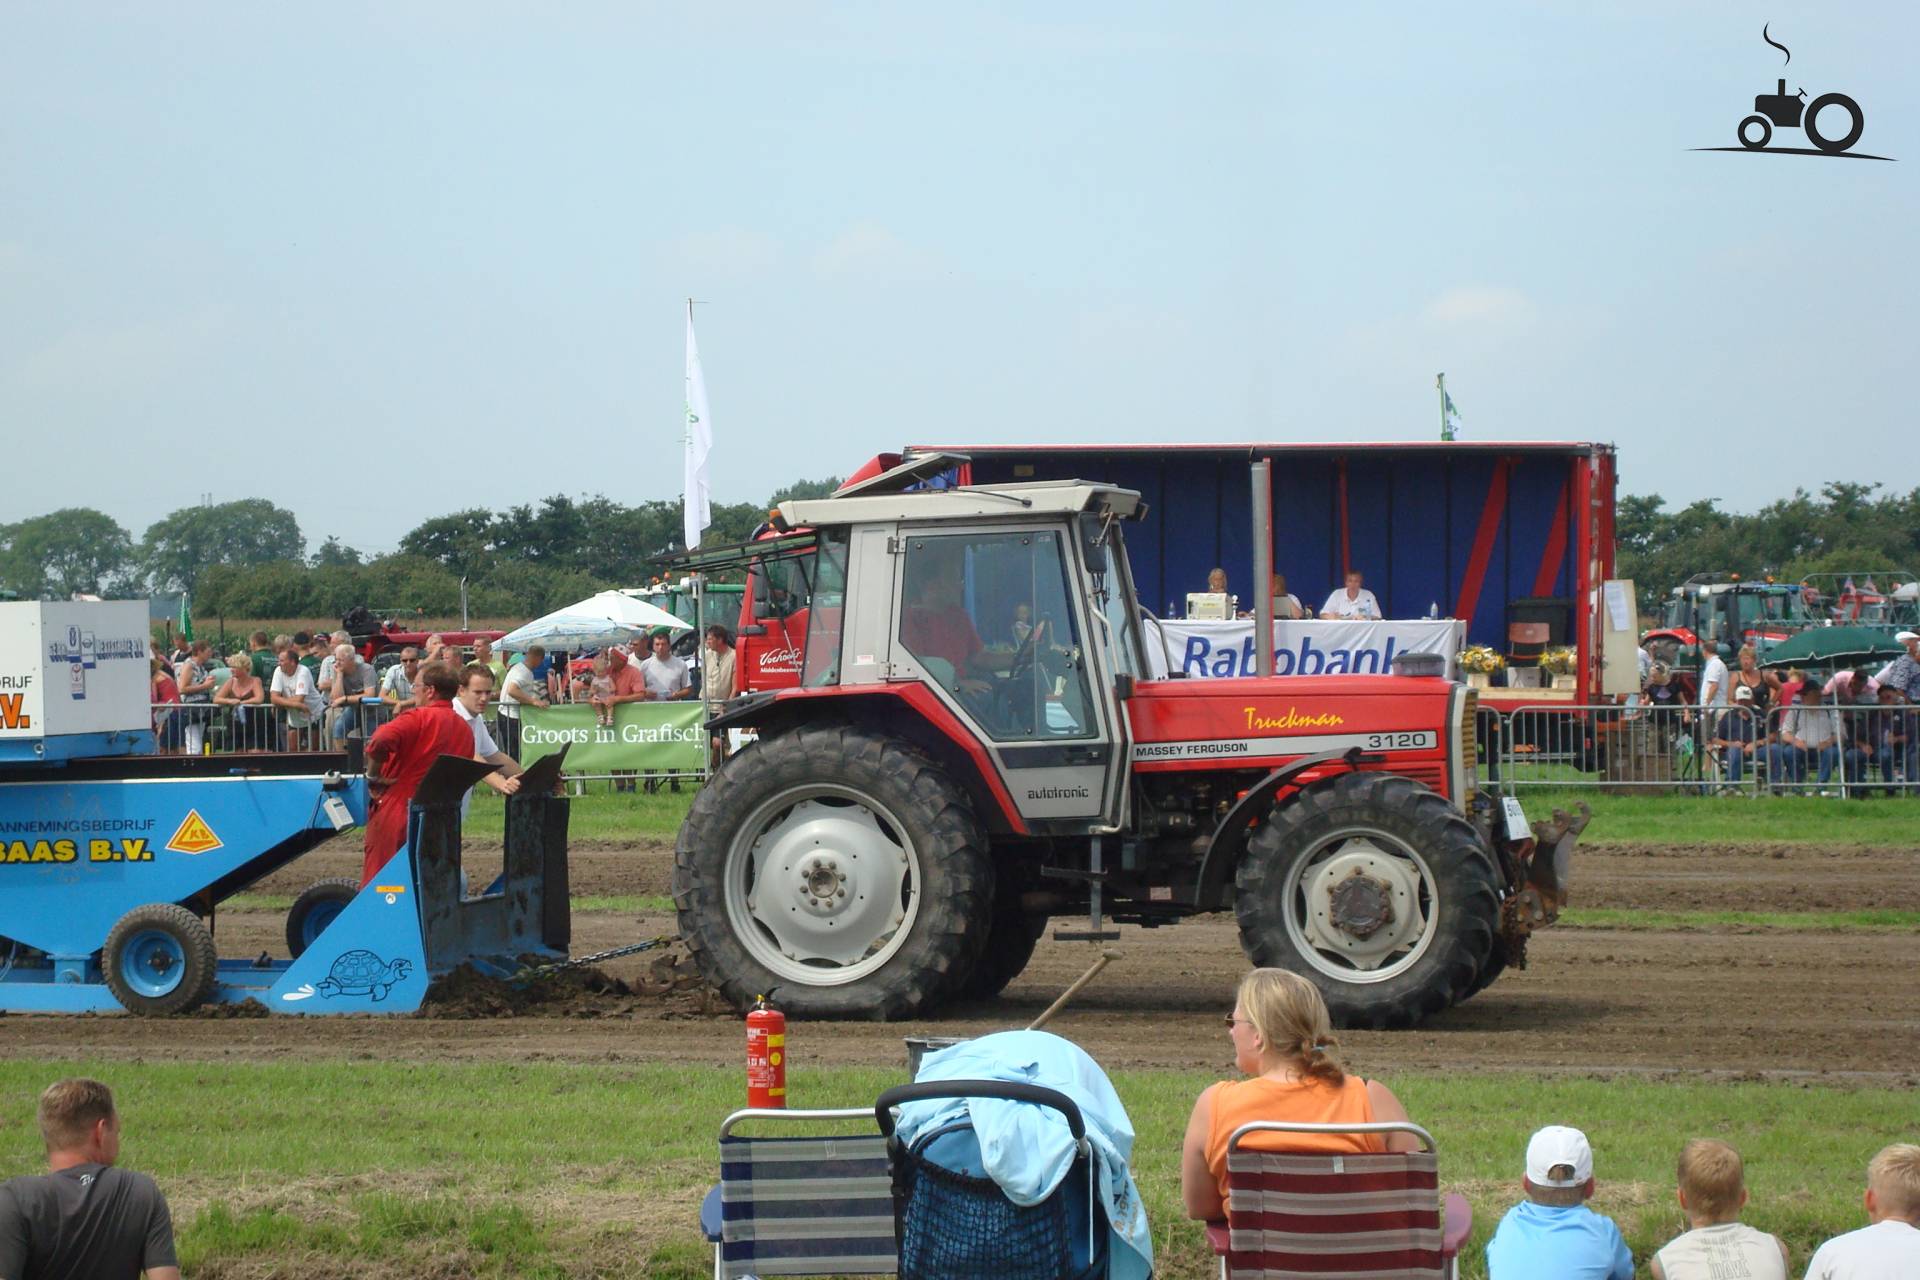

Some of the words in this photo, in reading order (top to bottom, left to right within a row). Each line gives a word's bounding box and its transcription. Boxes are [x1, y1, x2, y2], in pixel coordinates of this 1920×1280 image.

[1183, 636, 1412, 677] Rabobank
[0, 676, 32, 688] RIJF
[1244, 707, 1344, 729] Truckman
[522, 725, 589, 744] Groots
[594, 724, 616, 743] in
[622, 723, 704, 743] Grafisch
[1368, 733, 1427, 748] 3120
[1136, 745, 1183, 757] MASSEY
[1187, 742, 1248, 754] FERGUSON
[1027, 785, 1089, 799] autotronic
[90, 838, 154, 863] B.V.
